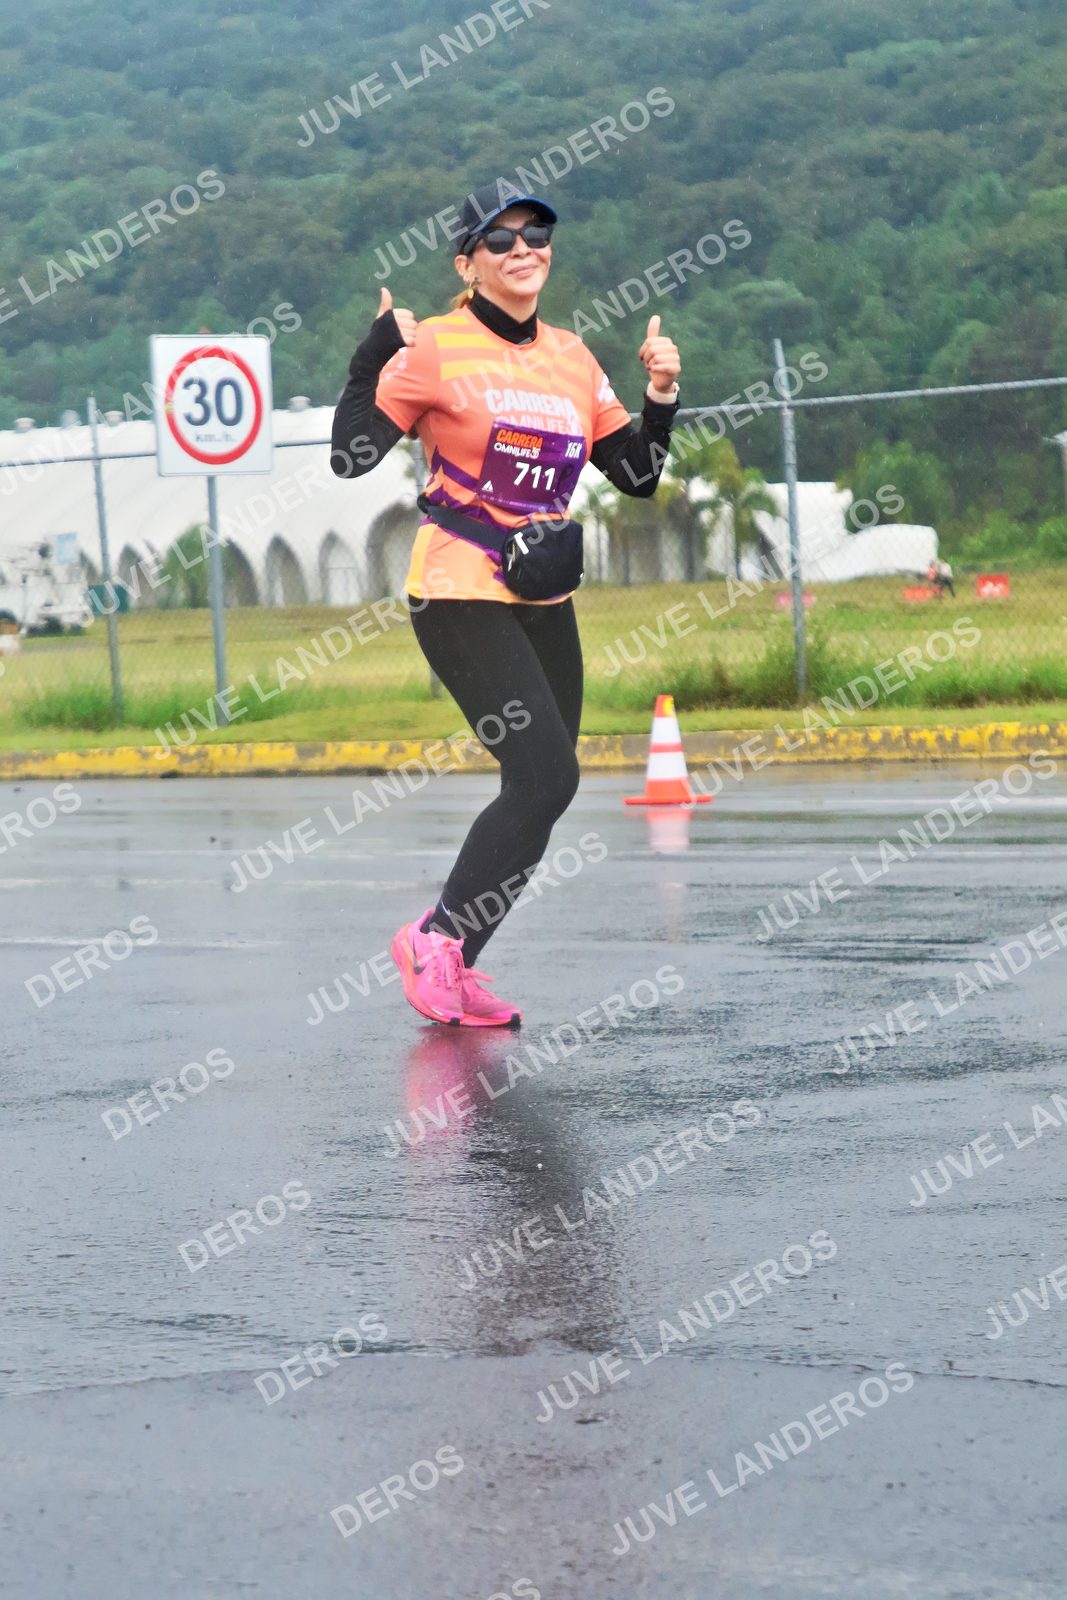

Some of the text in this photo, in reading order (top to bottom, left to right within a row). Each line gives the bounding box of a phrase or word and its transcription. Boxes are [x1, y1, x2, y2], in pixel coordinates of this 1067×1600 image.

[182, 377, 243, 427] 30
[485, 388, 579, 418] CARRERA
[496, 429, 543, 449] CARRERA
[514, 462, 556, 490] 711
